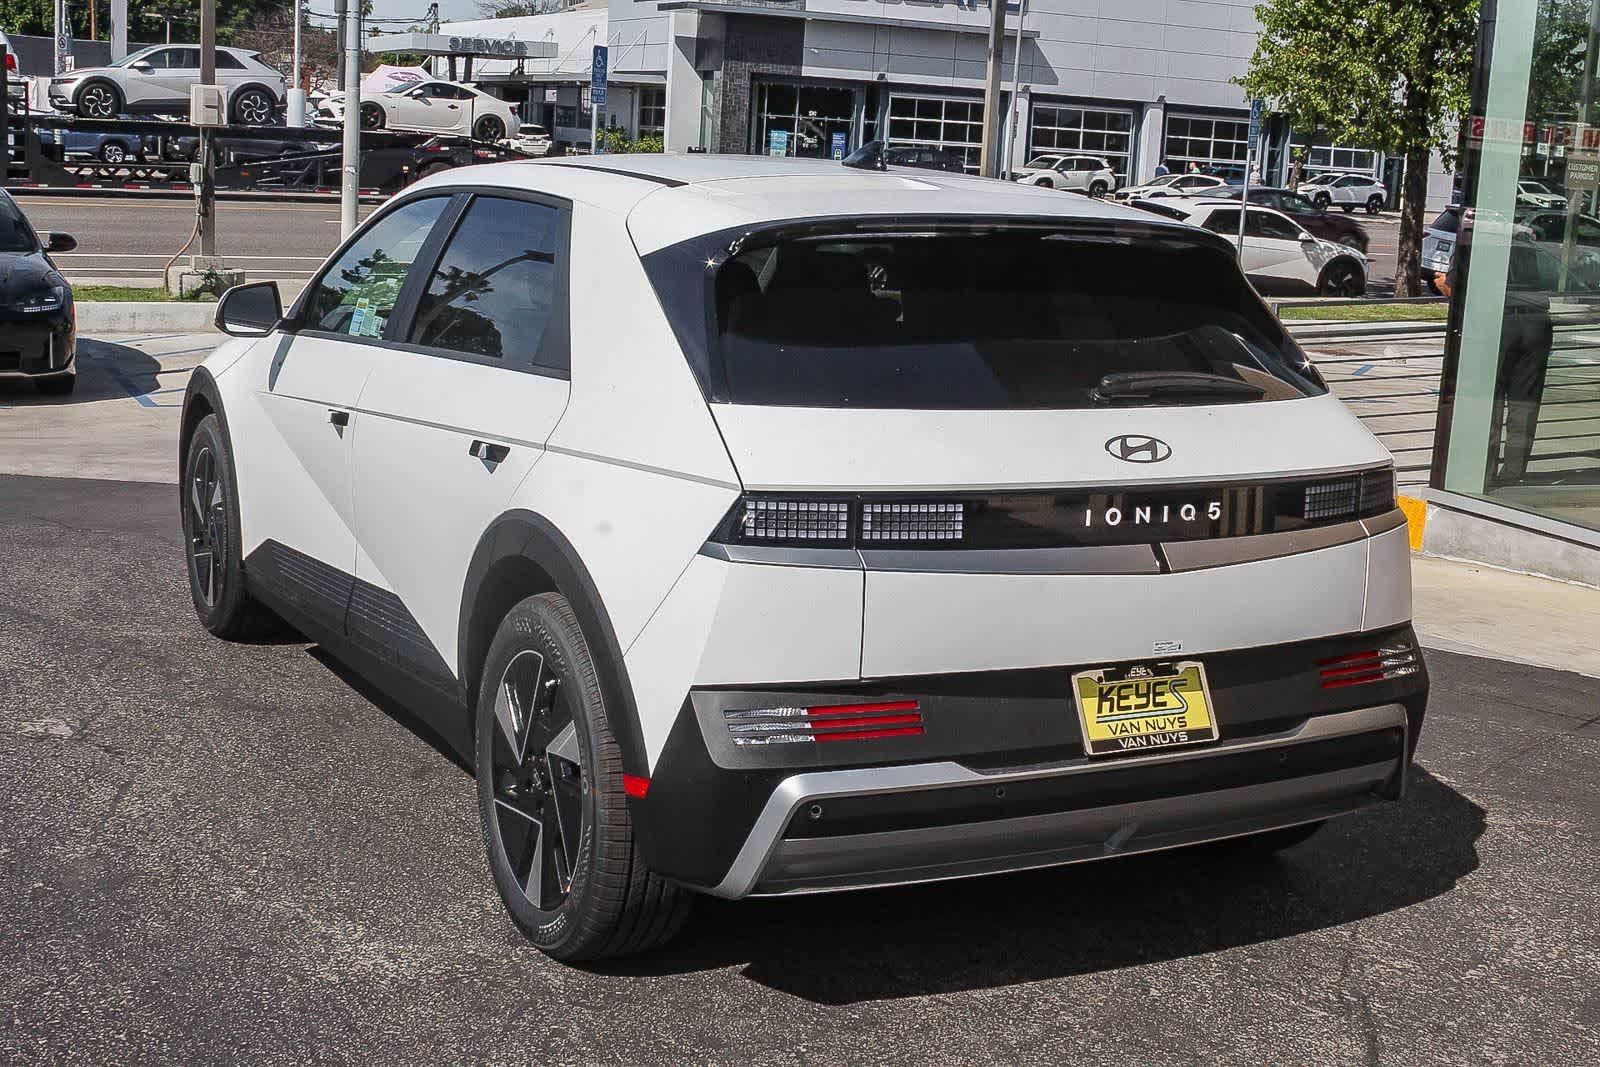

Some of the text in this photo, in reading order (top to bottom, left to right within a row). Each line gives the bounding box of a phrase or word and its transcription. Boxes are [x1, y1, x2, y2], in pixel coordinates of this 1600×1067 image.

[449, 37, 528, 56] SERVICE
[1567, 162, 1599, 173] CUSTOMER
[1085, 502, 1221, 527] IONIQ 5
[1096, 679, 1189, 720] KEYES
[1107, 716, 1188, 736] VAN NUYS
[1118, 731, 1188, 749] VAN NUYS
